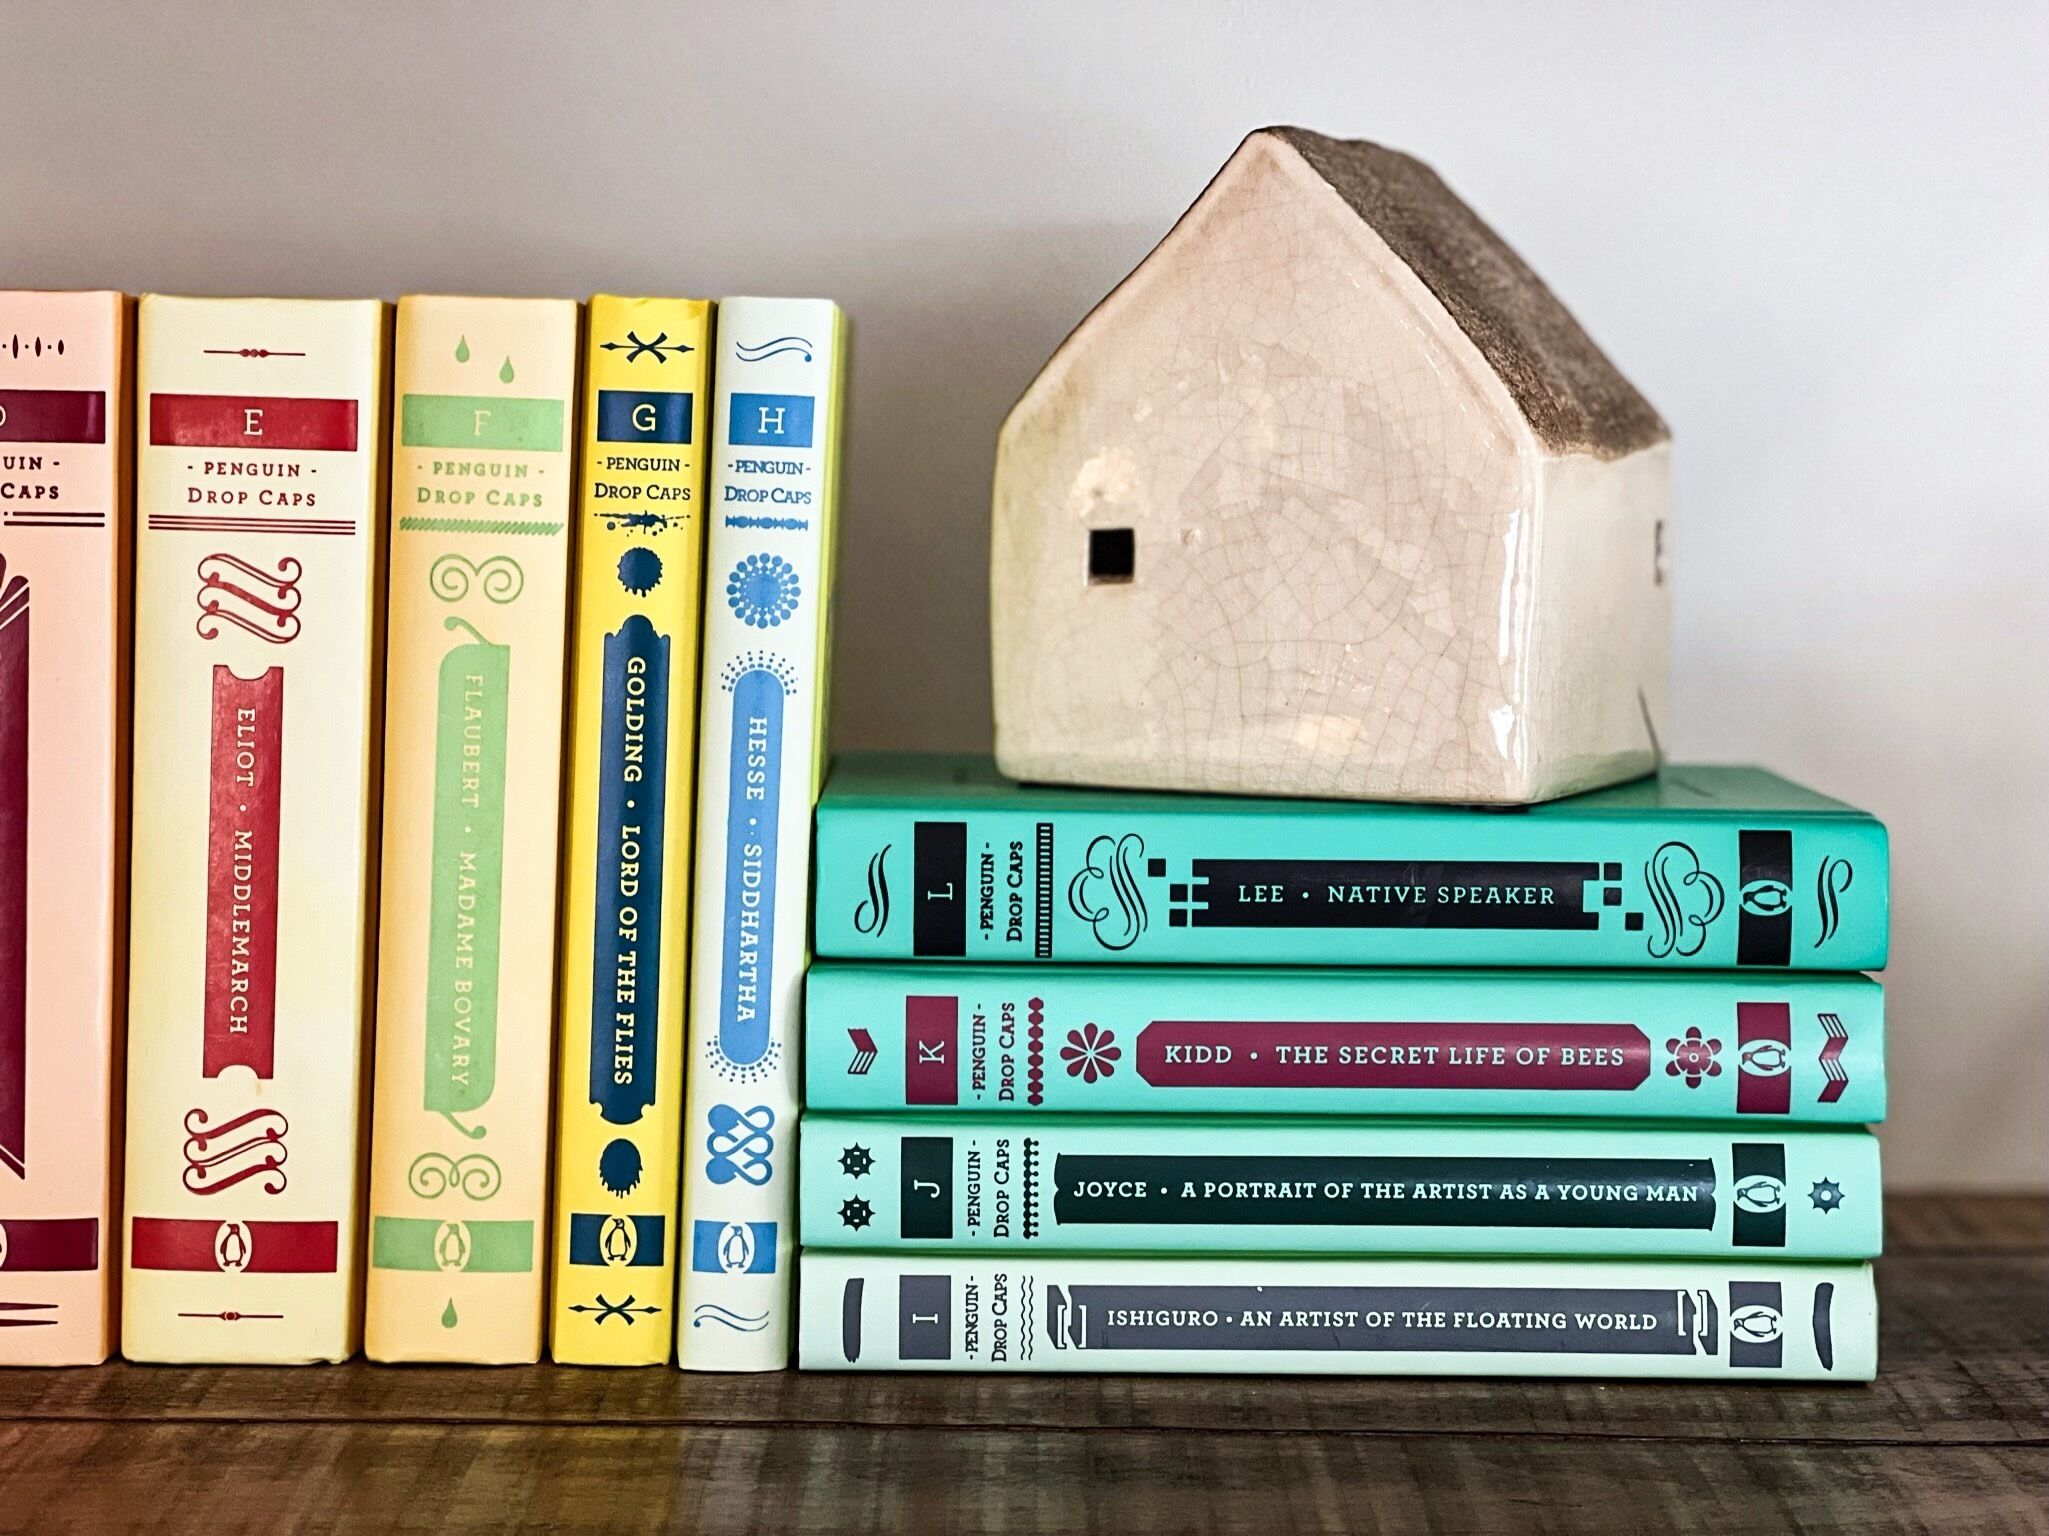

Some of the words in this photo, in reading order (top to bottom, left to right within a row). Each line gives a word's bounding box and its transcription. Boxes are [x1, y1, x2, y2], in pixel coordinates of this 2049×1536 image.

[244, 409, 263, 435] E
[474, 410, 491, 436] F
[632, 404, 655, 431] G
[758, 407, 785, 434] H
[624, 657, 645, 781] GOLDING
[237, 708, 256, 786] ELIOT
[461, 675, 483, 809] FLAUBERT
[747, 717, 767, 800] HESSE
[621, 826, 640, 896] LORD
[928, 883, 952, 900] L
[1239, 885, 1283, 902] LEE
[1328, 886, 1426, 903] NATIVE
[1438, 887, 1553, 904] SPEAKER
[456, 851, 476, 968] MADAME
[619, 907, 637, 941] OF
[230, 831, 252, 1032] MIDDLEMARCH
[736, 844, 762, 1022] SIDDHARTHA
[617, 951, 636, 1003] THE
[452, 981, 472, 1088] BOVARY
[614, 1013, 634, 1084] FLIES
[919, 1041, 944, 1064] K
[1165, 1046, 1231, 1063] KIDD
[1276, 1046, 1328, 1063] THE
[1339, 1046, 1439, 1064] SECRET
[1449, 1047, 1505, 1064] LIFE
[1516, 1048, 1550, 1064] OF
[1561, 1048, 1624, 1065] BEES
[914, 1180, 940, 1198] J
[1074, 1182, 1146, 1197] JOYCE
[1181, 1182, 1196, 1197] A
[1204, 1182, 1316, 1198] PORTRAIT
[1324, 1183, 1353, 1198] OF
[1361, 1183, 1405, 1198] THE
[1413, 1184, 1492, 1199] ARTIST
[1500, 1184, 1526, 1199] AS
[1535, 1184, 1549, 1199] A
[1557, 1184, 1637, 1200] YOUNG
[1645, 1186, 1697, 1201] MAN
[913, 1314, 938, 1323] I
[1108, 1310, 1218, 1326] ISHIGURO
[1240, 1311, 1272, 1326] AN
[1279, 1311, 1358, 1327] ARTIST
[1366, 1312, 1394, 1327] OF
[1402, 1312, 1445, 1327] THE
[1454, 1312, 1566, 1328] FLOATING
[1575, 1314, 1657, 1329] WORLD
